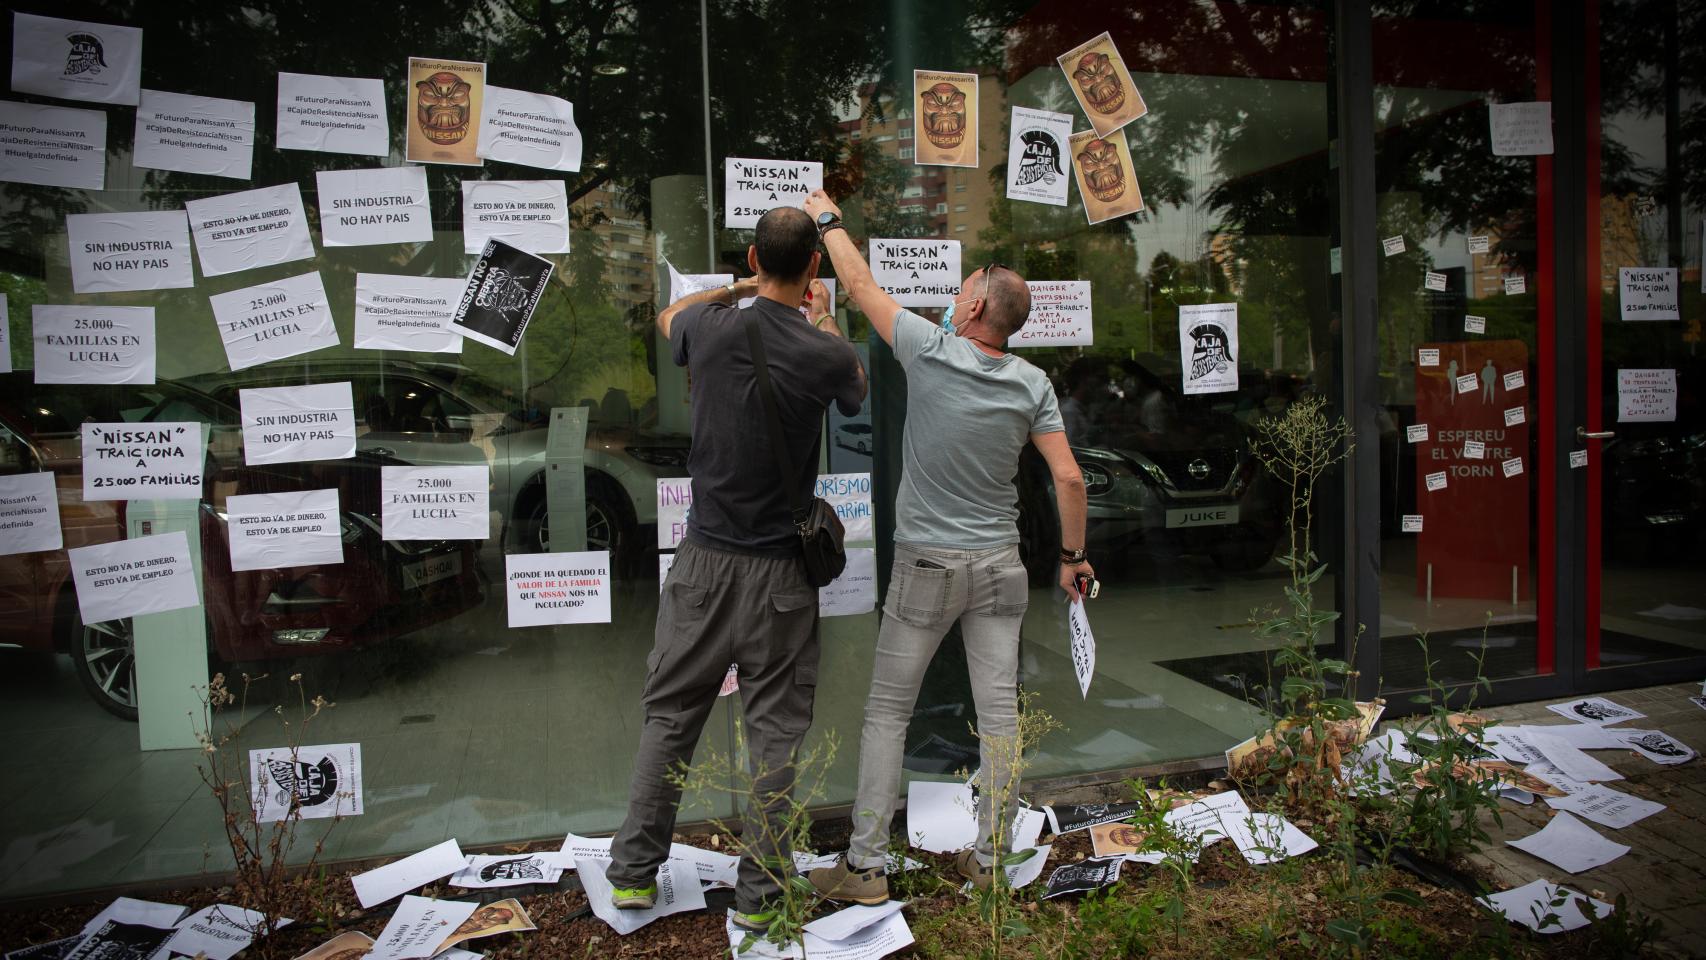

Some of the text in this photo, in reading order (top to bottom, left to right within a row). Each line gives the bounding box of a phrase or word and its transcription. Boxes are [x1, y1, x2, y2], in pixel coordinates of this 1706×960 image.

[294, 94, 372, 108] #FuturoParaNissanYA
[286, 105, 380, 120] #CajaDeResistenciaNissan
[154, 112, 236, 129] #FuturoParaNissanYA
[299, 118, 366, 131] #HuelgaIndefinida
[145, 123, 243, 142] #CajaDeResistenciaNissan
[422, 128, 467, 142] NISSAN
[0, 136, 94, 152] ajaDeResistenciaNissan
[158, 137, 228, 152] #HuelgaIndefinida
[1026, 143, 1052, 157] CAJA
[4, 149, 78, 163] #HuelgaIndefinida
[1036, 155, 1052, 165] DE
[332, 195, 414, 209] SIN INDUSTRIA
[768, 192, 779, 202] A
[473, 202, 493, 211] ESTO
[517, 202, 528, 210] DE
[203, 218, 224, 230] ESTO
[250, 212, 261, 222] DE
[340, 212, 411, 227] NO HAY PAIS
[479, 214, 498, 222] ESTO
[211, 230, 232, 241] ESTO
[245, 226, 257, 235] DE
[257, 221, 289, 234] EMPLEO
[84, 239, 174, 254] SIN INDUSTRIA
[92, 258, 170, 271] NO HAY PAIS
[457, 242, 497, 321] NISSAN NO SE
[910, 271, 920, 280] A
[249, 292, 288, 312] 25.000
[371, 295, 448, 307] #FuturoParaNissanYA
[72, 318, 114, 330] 25.000
[229, 302, 316, 333] FAMILIAS EN
[376, 318, 441, 330] #HuelgaIndefinida
[253, 322, 303, 344] LUCHA
[46, 334, 141, 347] FAMILIAS EN
[1196, 337, 1222, 349] CAJA
[67, 350, 120, 362] LUCHA
[256, 411, 338, 426] SIN INDUSTRIA
[263, 430, 335, 444] NO HAY PAIS
[1437, 429, 1506, 443] ESPEREU
[1431, 447, 1449, 461] EL
[1451, 446, 1513, 461] VTRE
[136, 459, 148, 469] A
[1449, 465, 1495, 478] TORN
[416, 477, 452, 489] 25.000
[815, 476, 870, 497] ORISMO
[392, 493, 476, 506] FAMILIAS EN
[239, 516, 260, 525] ESTO
[285, 513, 296, 521] DE
[411, 508, 458, 520] LUCHA
[1178, 510, 1228, 526] JUKE
[245, 528, 266, 537] ESTO
[280, 526, 291, 534] DE
[291, 524, 322, 534] EMPLEO
[85, 566, 107, 577] ESTO
[134, 560, 146, 569] DE
[544, 569, 556, 578] HA
[557, 569, 596, 579] QUEDADO
[597, 567, 608, 576] EL
[93, 577, 115, 588] ESTO
[129, 573, 142, 583] DE
[142, 568, 174, 582] EMPLEO
[516, 581, 543, 590] VALOR
[569, 579, 602, 587] FAMILIA
[519, 589, 599, 600] QUE NISSAN NOS HA
[535, 599, 585, 609] INCULCADO?
[307, 765, 322, 797] CAJA
[1064, 808, 1136, 831] #FuturoParaNissanYa
